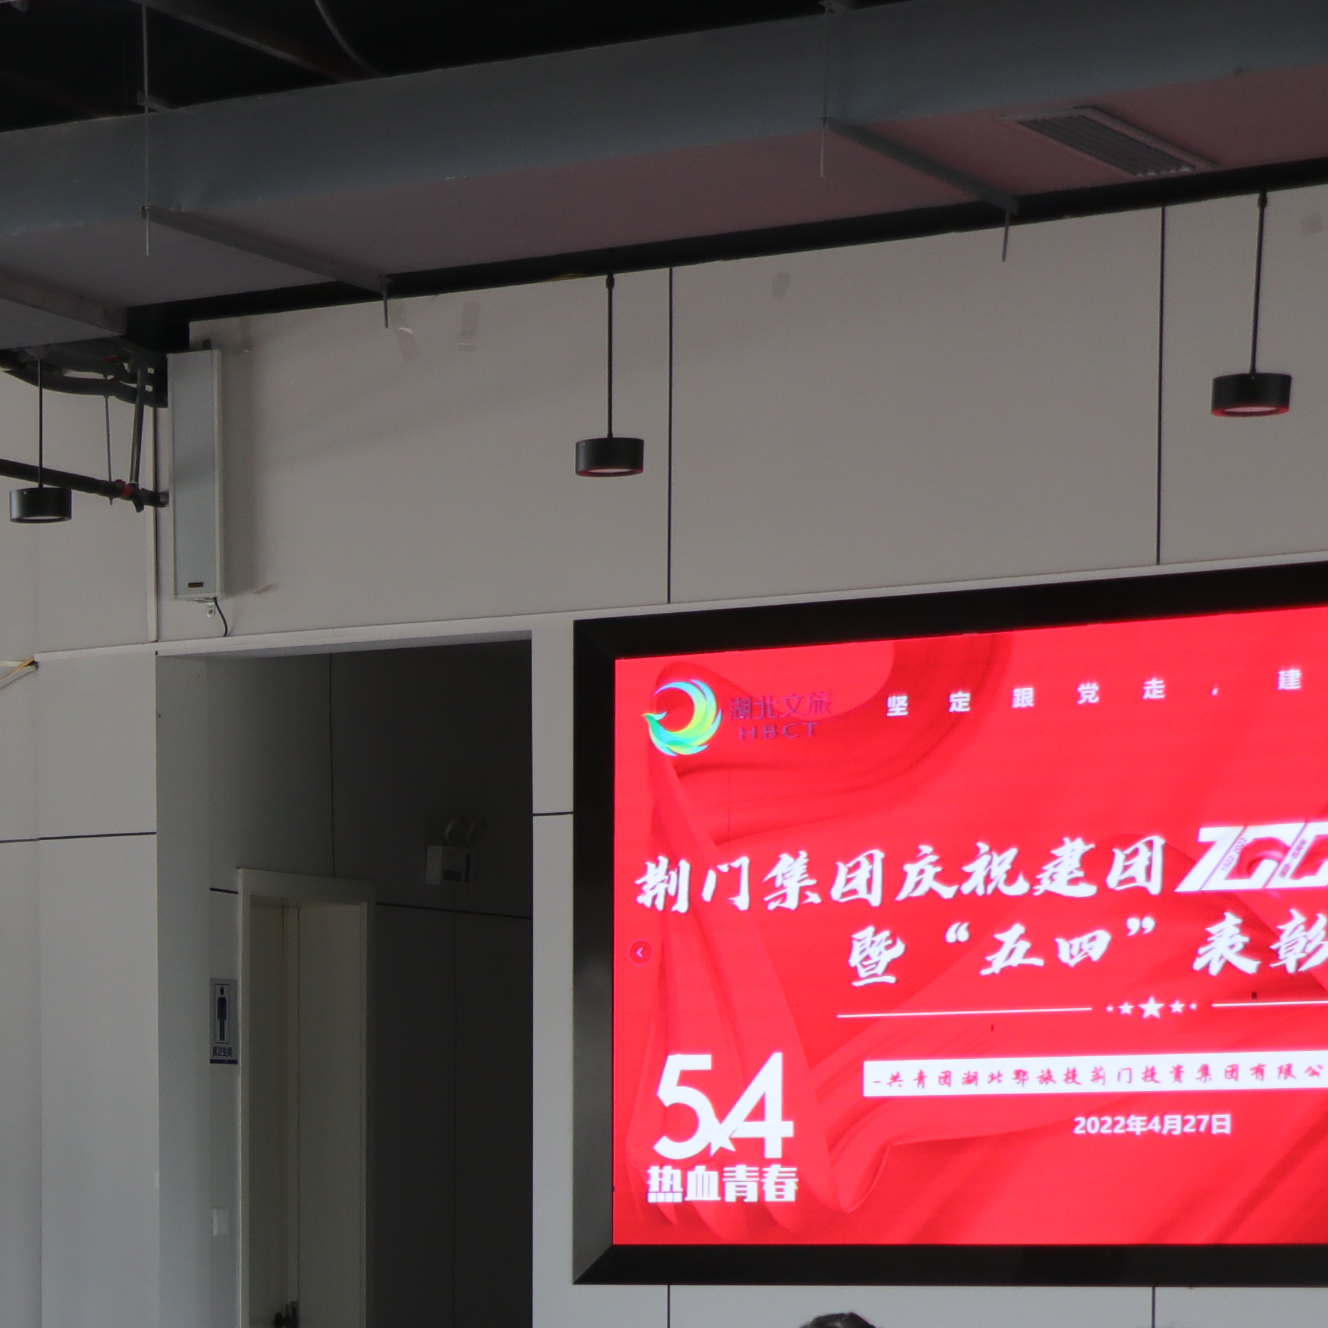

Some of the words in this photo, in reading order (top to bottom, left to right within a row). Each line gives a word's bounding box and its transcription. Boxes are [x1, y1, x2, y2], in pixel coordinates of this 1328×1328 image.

[730, 692, 833, 721] 湖北文旅
[739, 722, 818, 741] HBCT
[1073, 1113, 1232, 1136] 2022年4月27日
[647, 1164, 799, 1203] 热血青春
